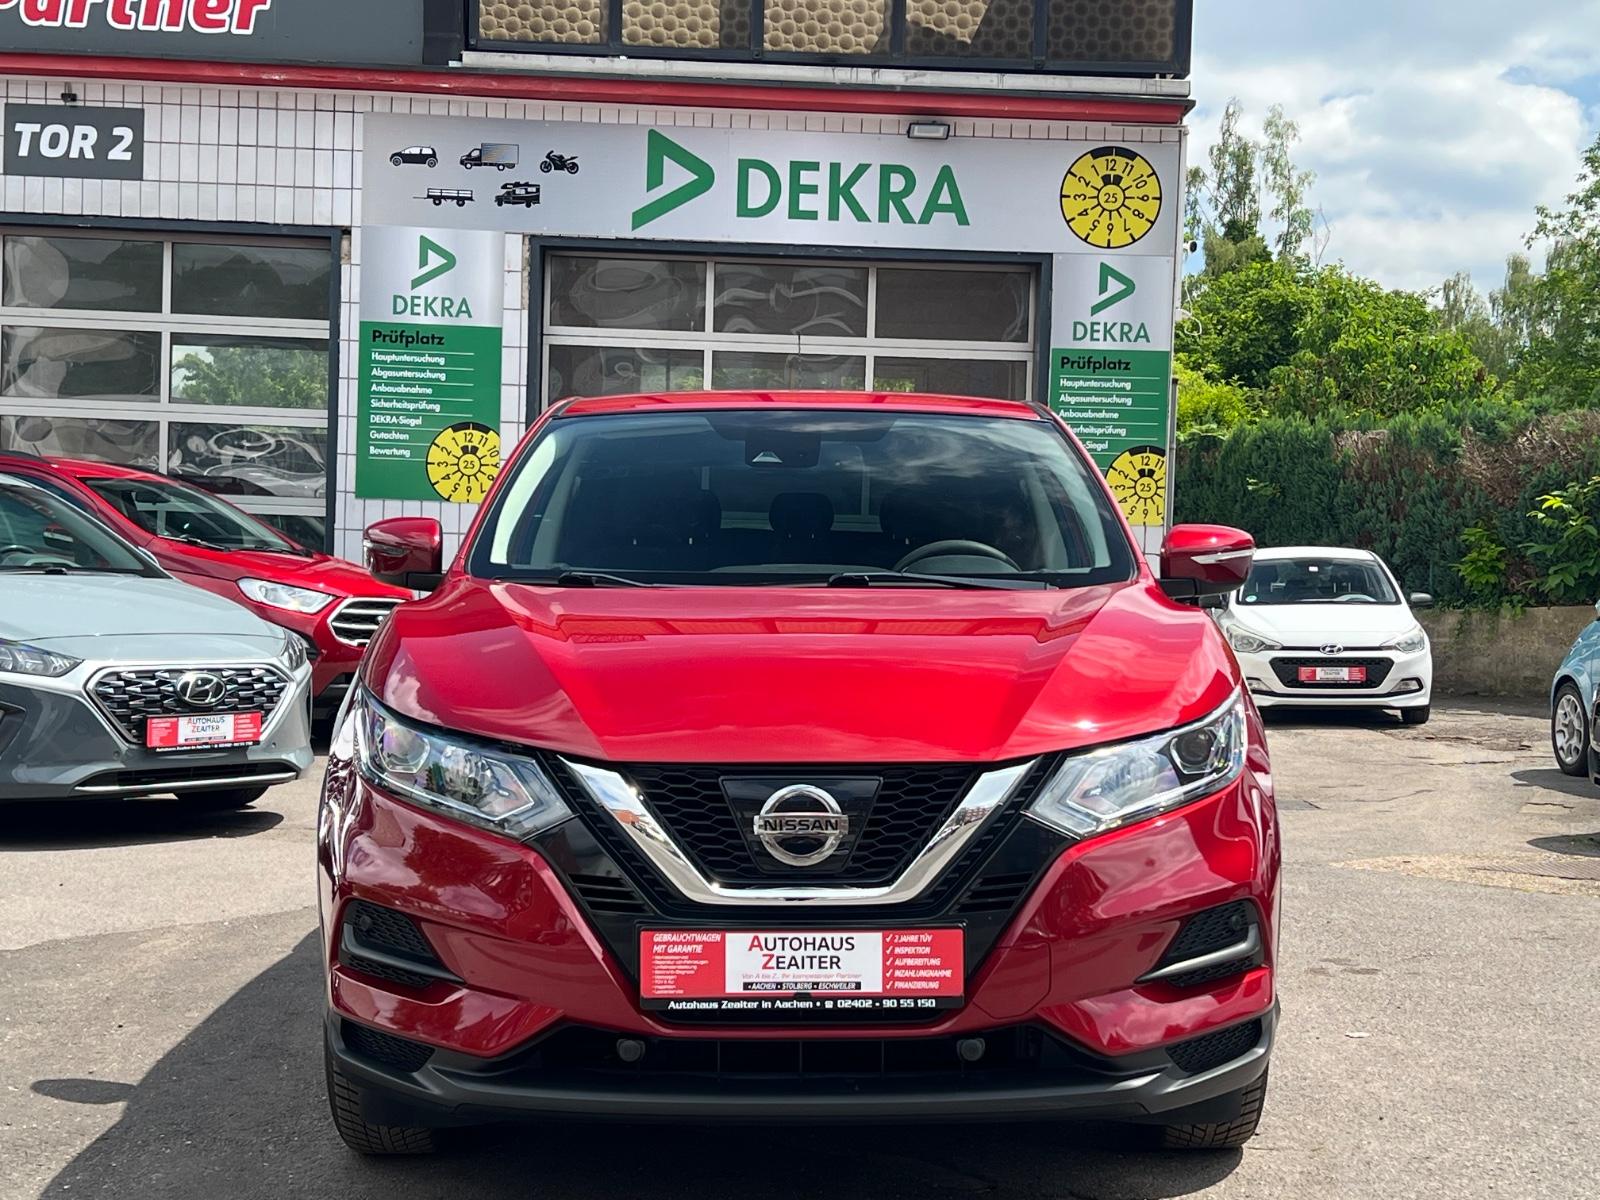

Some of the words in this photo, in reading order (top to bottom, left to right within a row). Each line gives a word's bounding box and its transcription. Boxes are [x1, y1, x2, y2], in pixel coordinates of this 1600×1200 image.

[0, 0, 271, 35] artner
[14, 122, 98, 160] TOR
[107, 126, 134, 161] 2
[1091, 164, 1100, 176] 1
[1105, 159, 1117, 171] 12
[1122, 161, 1134, 176] 11
[1077, 176, 1091, 187] 2
[1132, 174, 1148, 189] 10
[736, 158, 971, 226] DEKRA
[1073, 193, 1087, 201] 3
[1136, 194, 1150, 202] 9
[1104, 193, 1118, 204] 25
[1077, 208, 1089, 216] 4
[1132, 209, 1145, 219] 8
[1089, 219, 1100, 231] 5
[392, 294, 472, 319] DEKRA
[1072, 321, 1151, 343] DEKRA
[372, 329, 445, 348] Prüfplatz
[371, 352, 446, 366] Hauptuntersuchung
[1061, 356, 1132, 373] Prüfplatz
[371, 367, 446, 381] Abgasuntersuchung
[371, 383, 433, 395] Anbauabnahme
[1060, 378, 1132, 391] Hauptuntersuchung
[1059, 393, 1132, 406] Abgasuntersuchung
[370, 399, 441, 413] Sicherheitsprüfung
[1059, 409, 1119, 419] Anbauabnahme
[370, 414, 422, 427] DEKRA-Siegel
[370, 430, 409, 440] Gutachten
[464, 432, 474, 444] 12
[452, 437, 459, 447] 1
[478, 435, 489, 448] 11
[369, 446, 411, 457] Bewertung
[441, 446, 452, 457] 2
[487, 445, 500, 457] 10
[463, 460, 475, 469] 25
[1129, 460, 1136, 470] 1
[1141, 456, 1151, 466] 12
[1155, 458, 1165, 470] 11
[1118, 470, 1129, 480] 2
[452, 482, 460, 493] 5
[1140, 483, 1152, 493] 25
[1128, 505, 1137, 515] 5
[764, 819, 838, 831] NISSAN
[653, 933, 721, 943] GEBRAUCHTWAGEN
[900, 934, 919, 942] JAHRE
[919, 932, 933, 942] TÜV
[653, 944, 667, 954] MIT
[667, 944, 703, 954] GARANTIE
[748, 935, 855, 952] AUTOHAUS
[894, 946, 930, 954] INSPEKTION
[761, 953, 841, 970] ZEAITER
[894, 957, 941, 966] AUFBEREITUNG
[894, 981, 940, 989] FINANZIERUNG
[668, 1001, 719, 1010] Autohaus
[721, 1000, 759, 1010] Zeaiter
[774, 1000, 813, 1009] Aachen
[837, 999, 873, 1009] 02402
[882, 999, 897, 1008] 90
[900, 999, 914, 1008] 55
[917, 999, 936, 1008] 150
